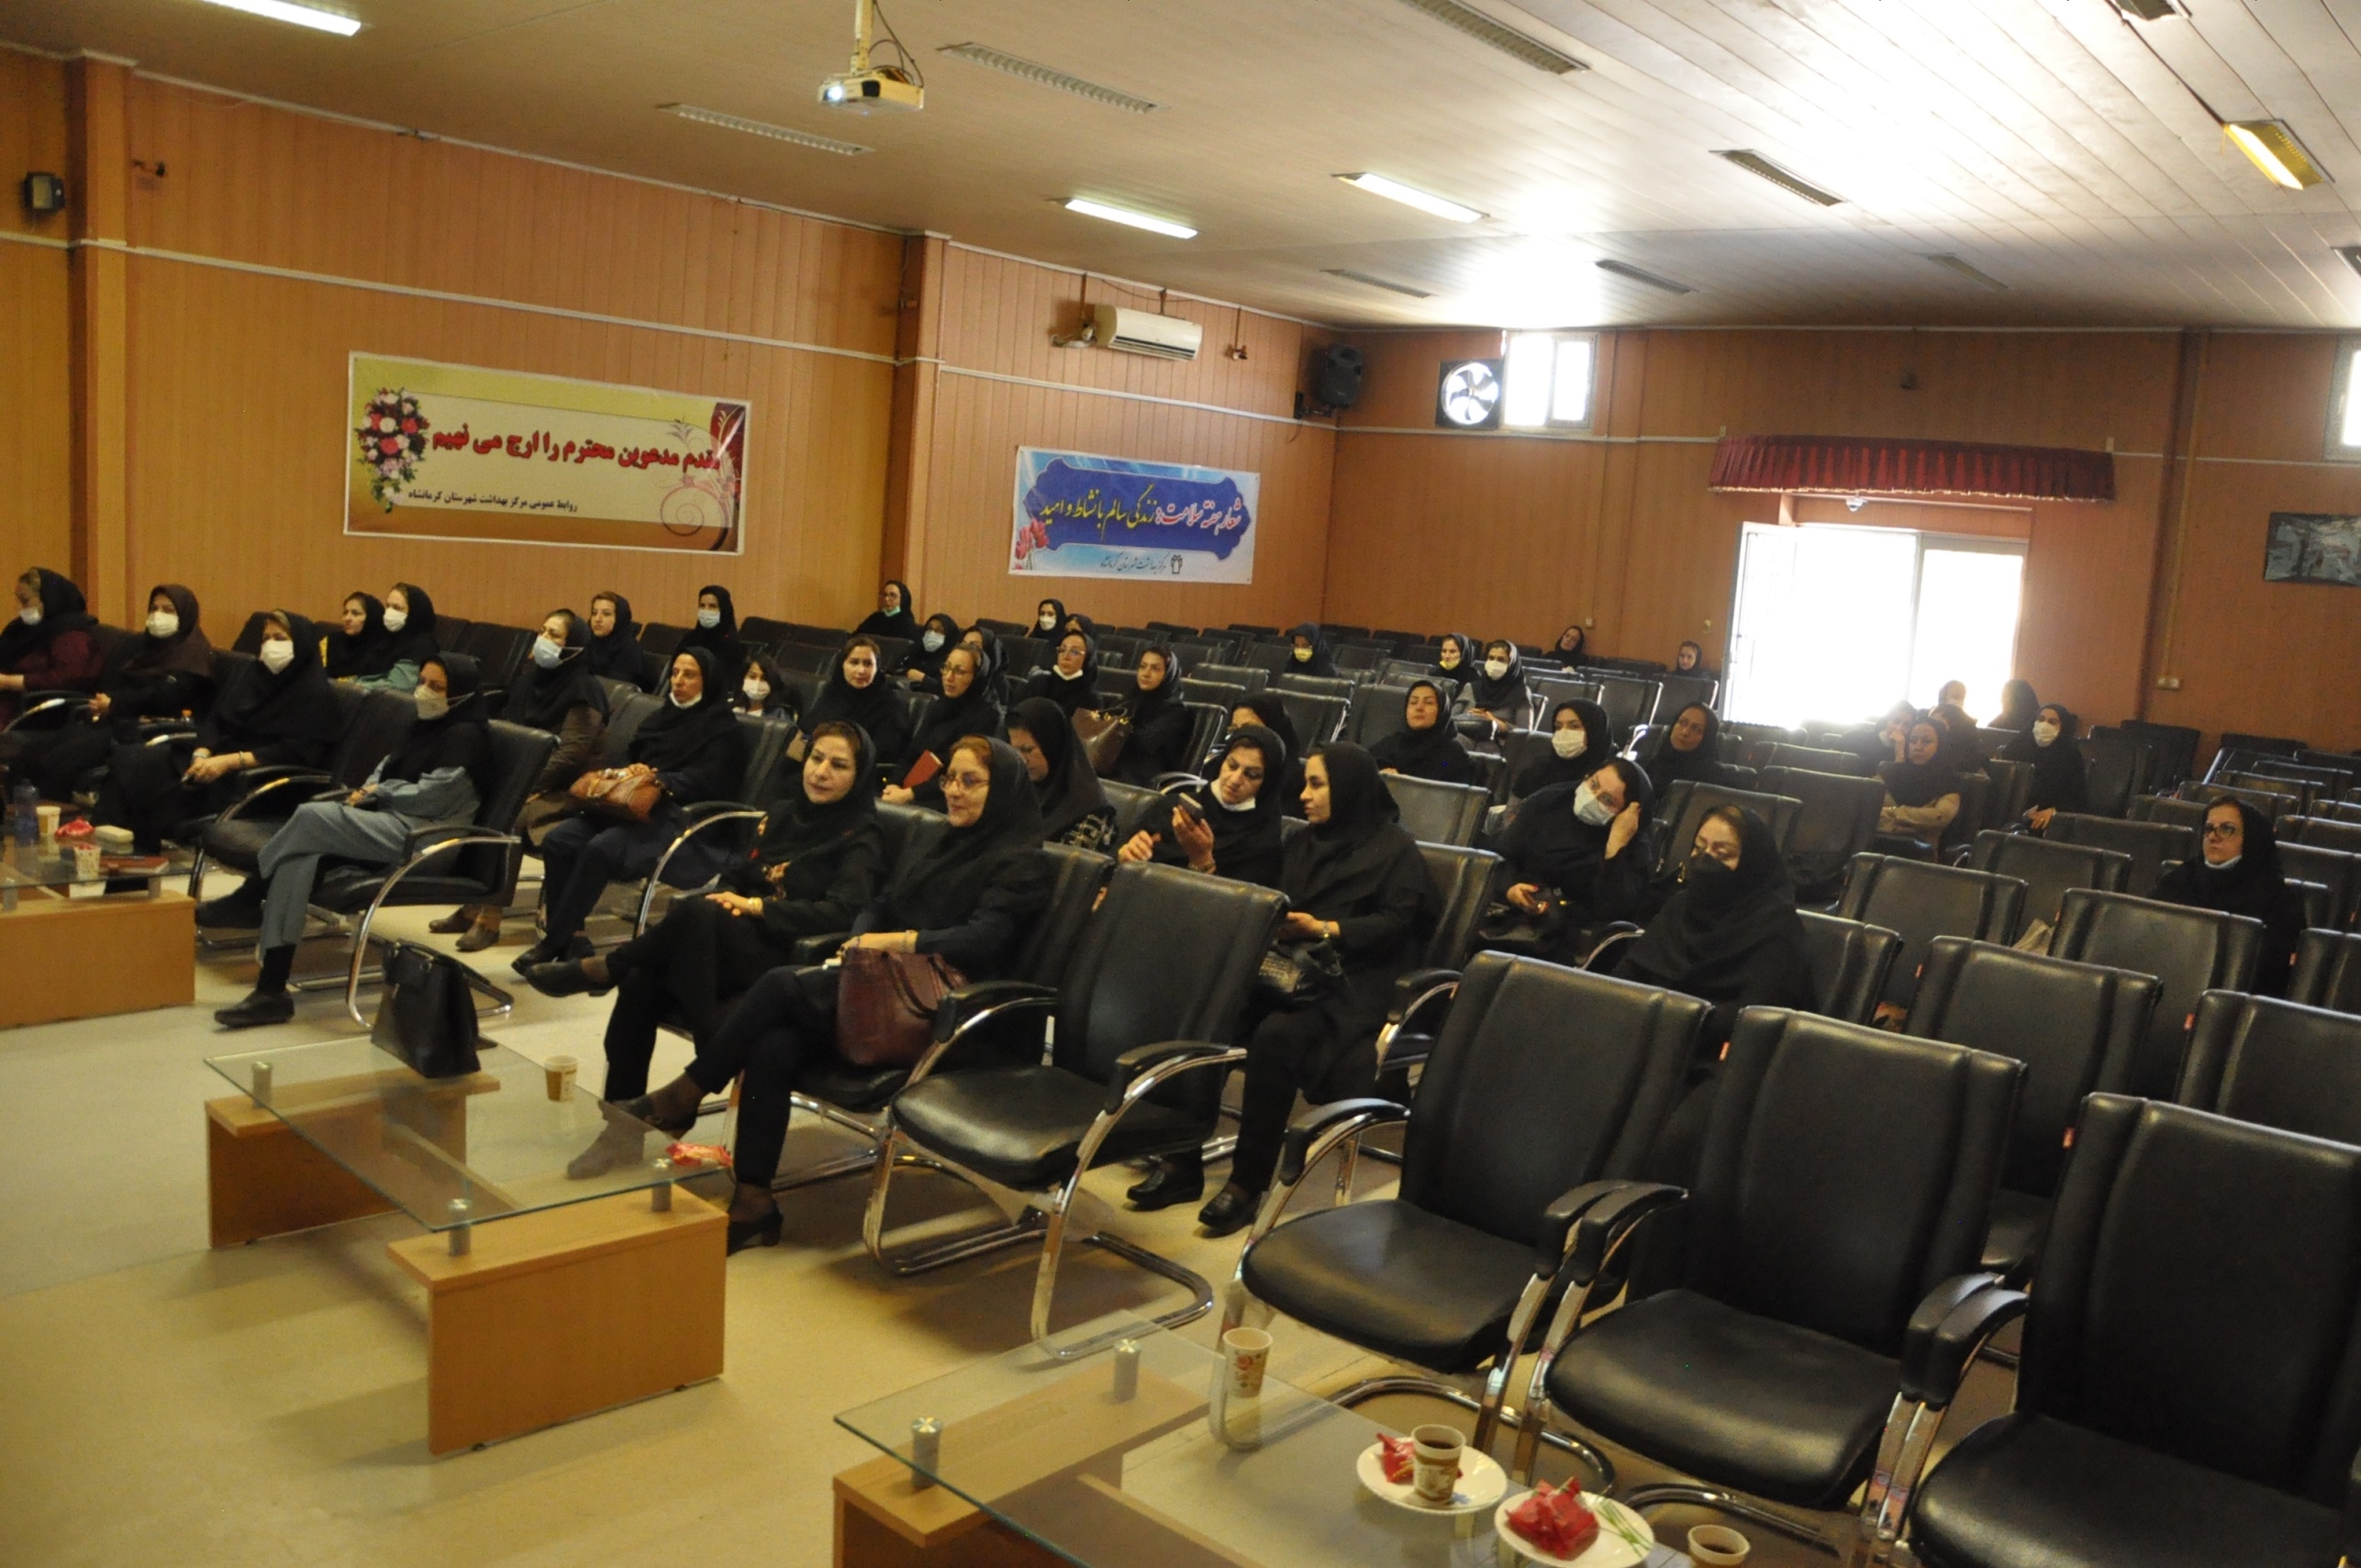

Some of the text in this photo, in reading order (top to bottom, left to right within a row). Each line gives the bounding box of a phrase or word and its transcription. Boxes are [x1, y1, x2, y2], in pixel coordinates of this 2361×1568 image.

[432, 422, 470, 450] نهیم
[473, 435, 503, 454] می
[506, 429, 540, 459] ارج
[543, 430, 560, 462] را
[562, 439, 615, 463] محترم
[618, 447, 680, 471] مدعوین
[444, 492, 477, 506] شهرستان
[479, 493, 507, 506] بهداشت
[509, 495, 528, 509] مرکز
[529, 502, 554, 511] عمومی
[557, 498, 578, 512] روابط
